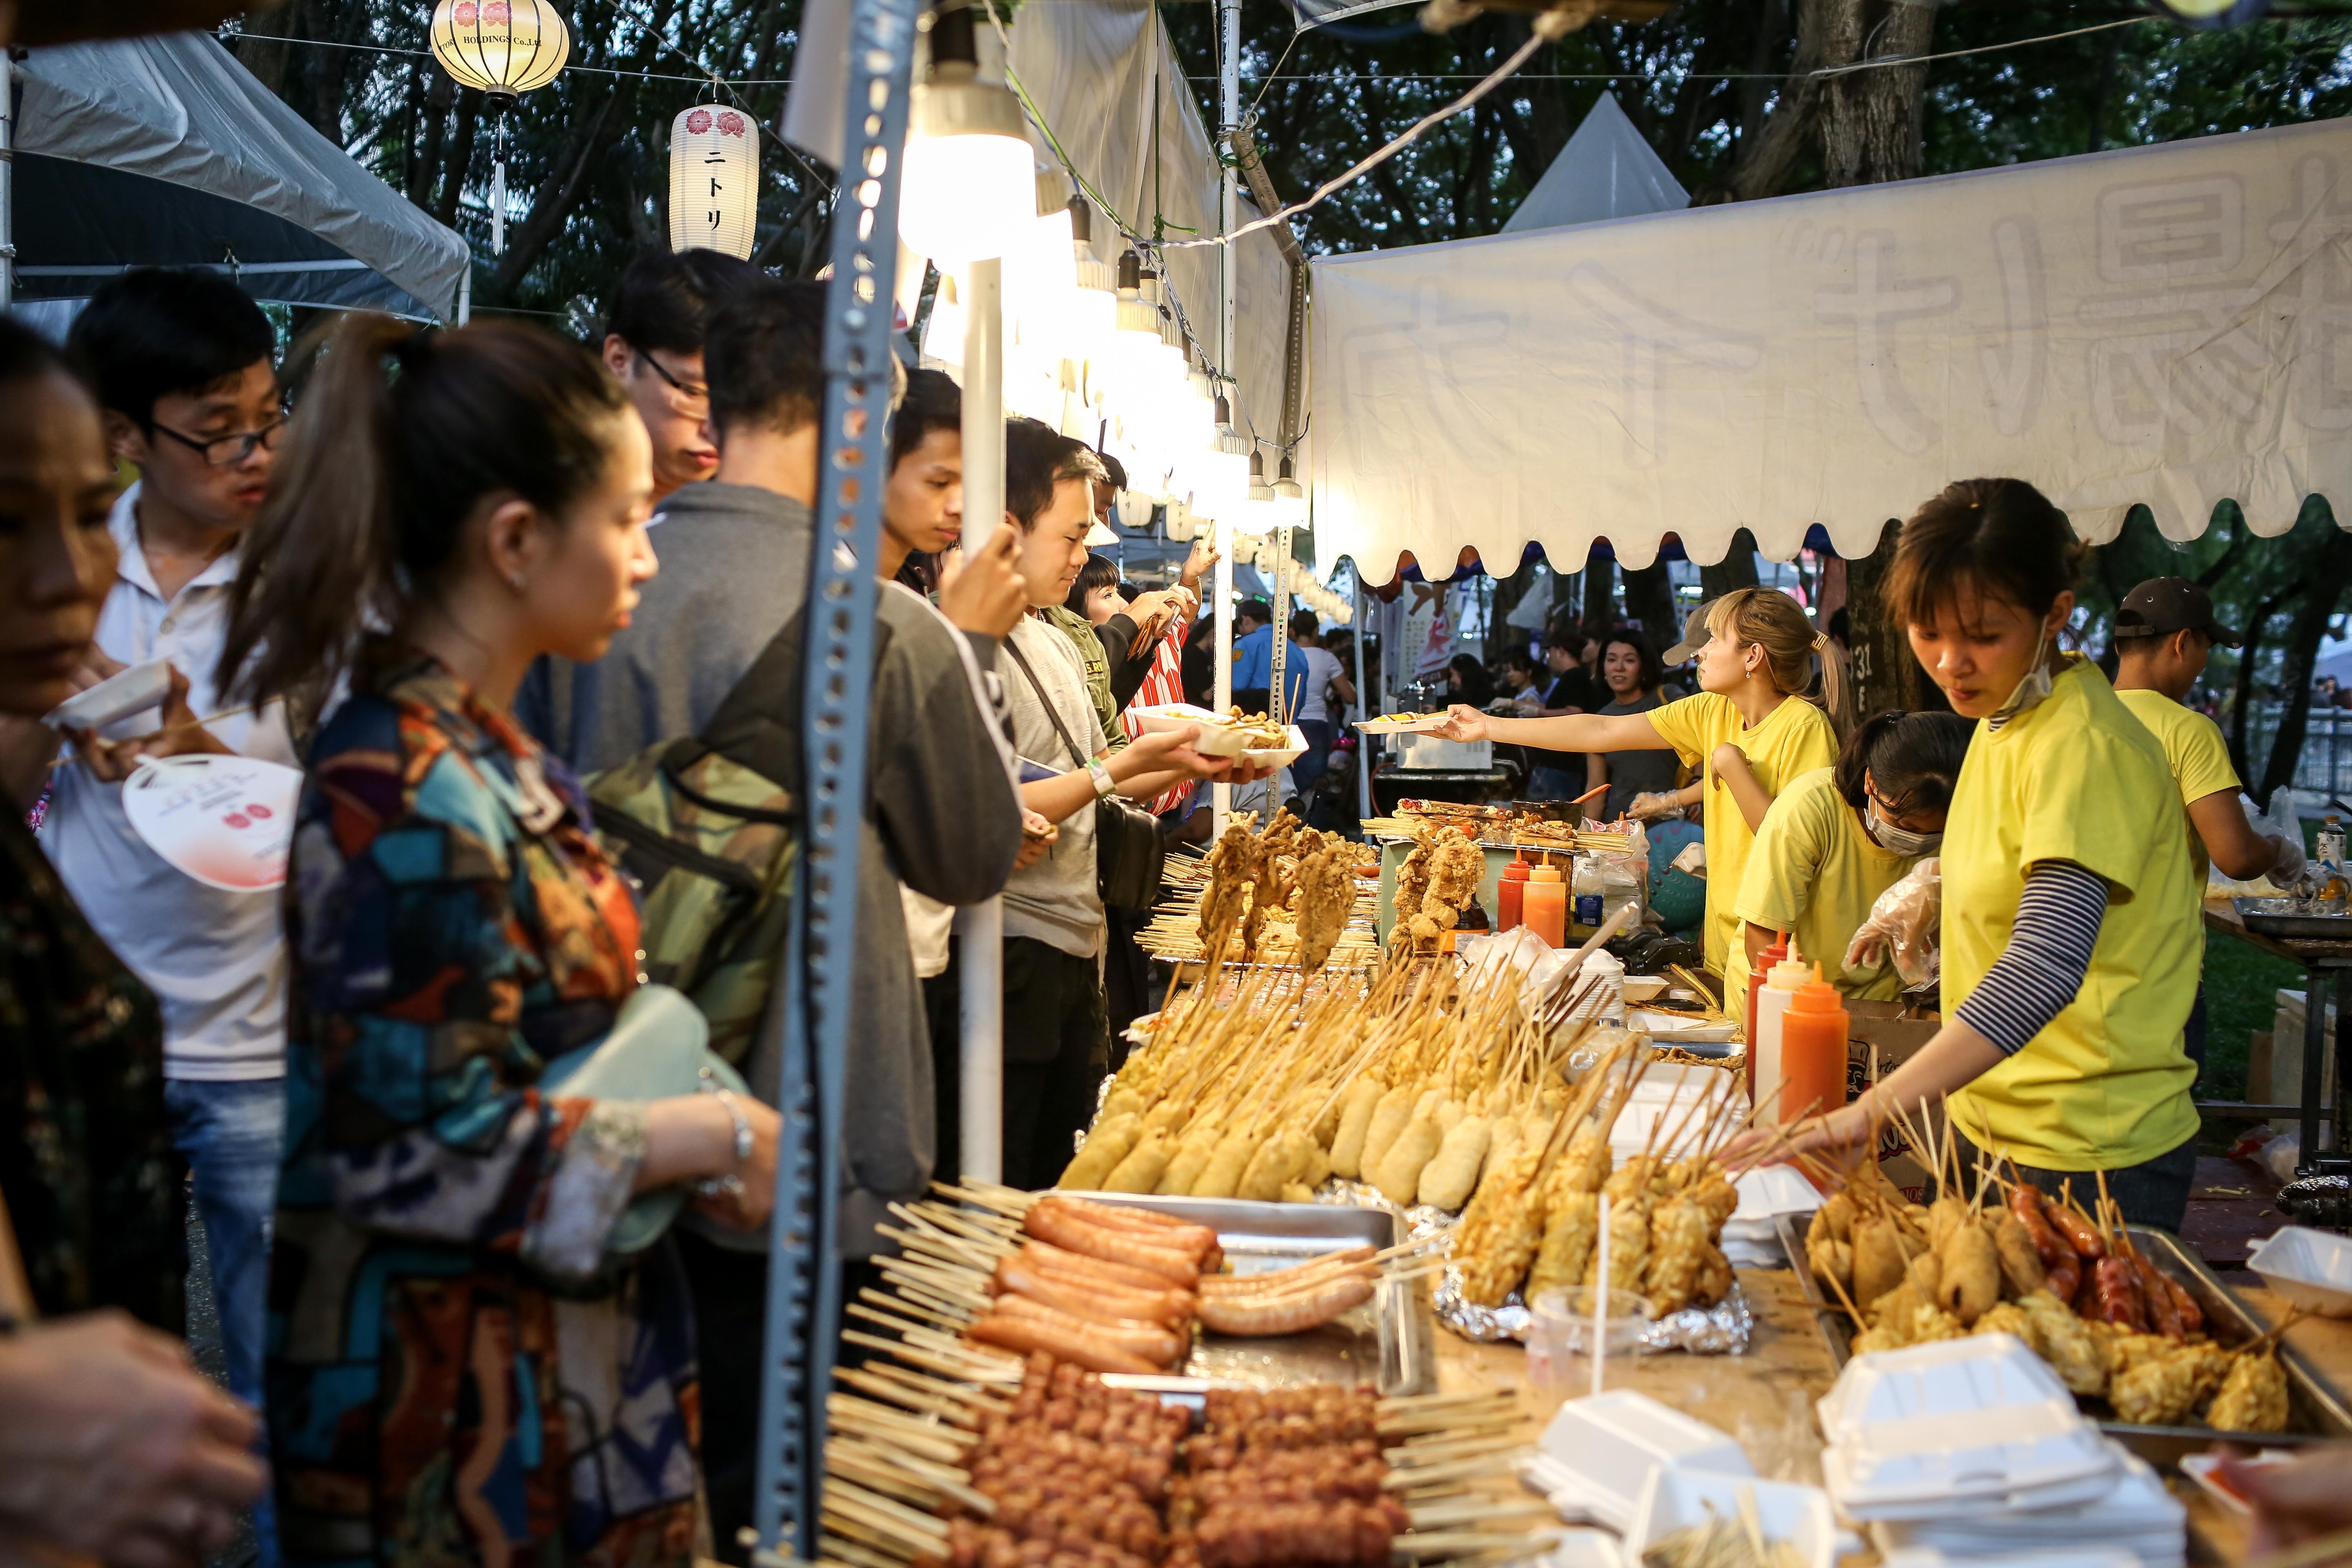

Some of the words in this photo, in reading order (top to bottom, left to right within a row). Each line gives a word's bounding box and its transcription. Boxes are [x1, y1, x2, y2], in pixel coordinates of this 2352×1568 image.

[463, 35, 511, 44] HOLDINGS
[704, 151, 726, 231] ニトリ
